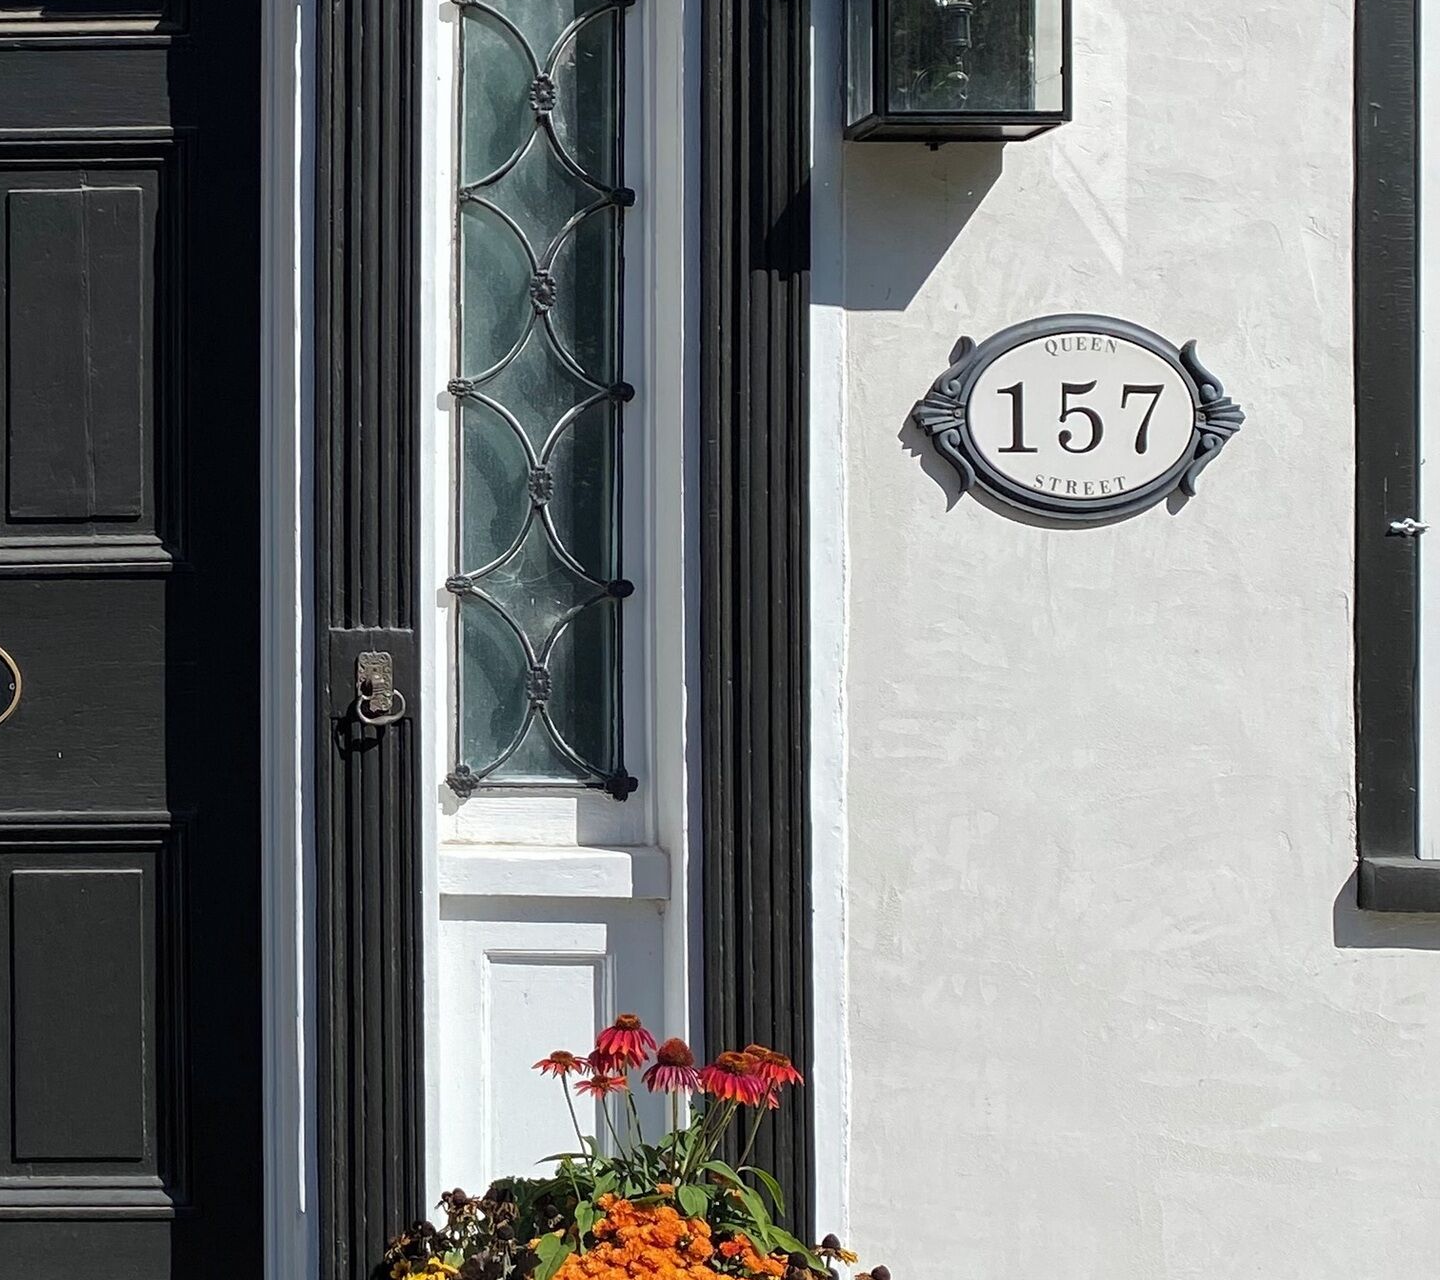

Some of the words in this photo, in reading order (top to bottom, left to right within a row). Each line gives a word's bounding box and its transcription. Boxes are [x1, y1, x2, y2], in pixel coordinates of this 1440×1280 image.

[1044, 338, 1119, 356] QUEEN
[996, 379, 1165, 455] 157
[1033, 473, 1128, 496] STREET
